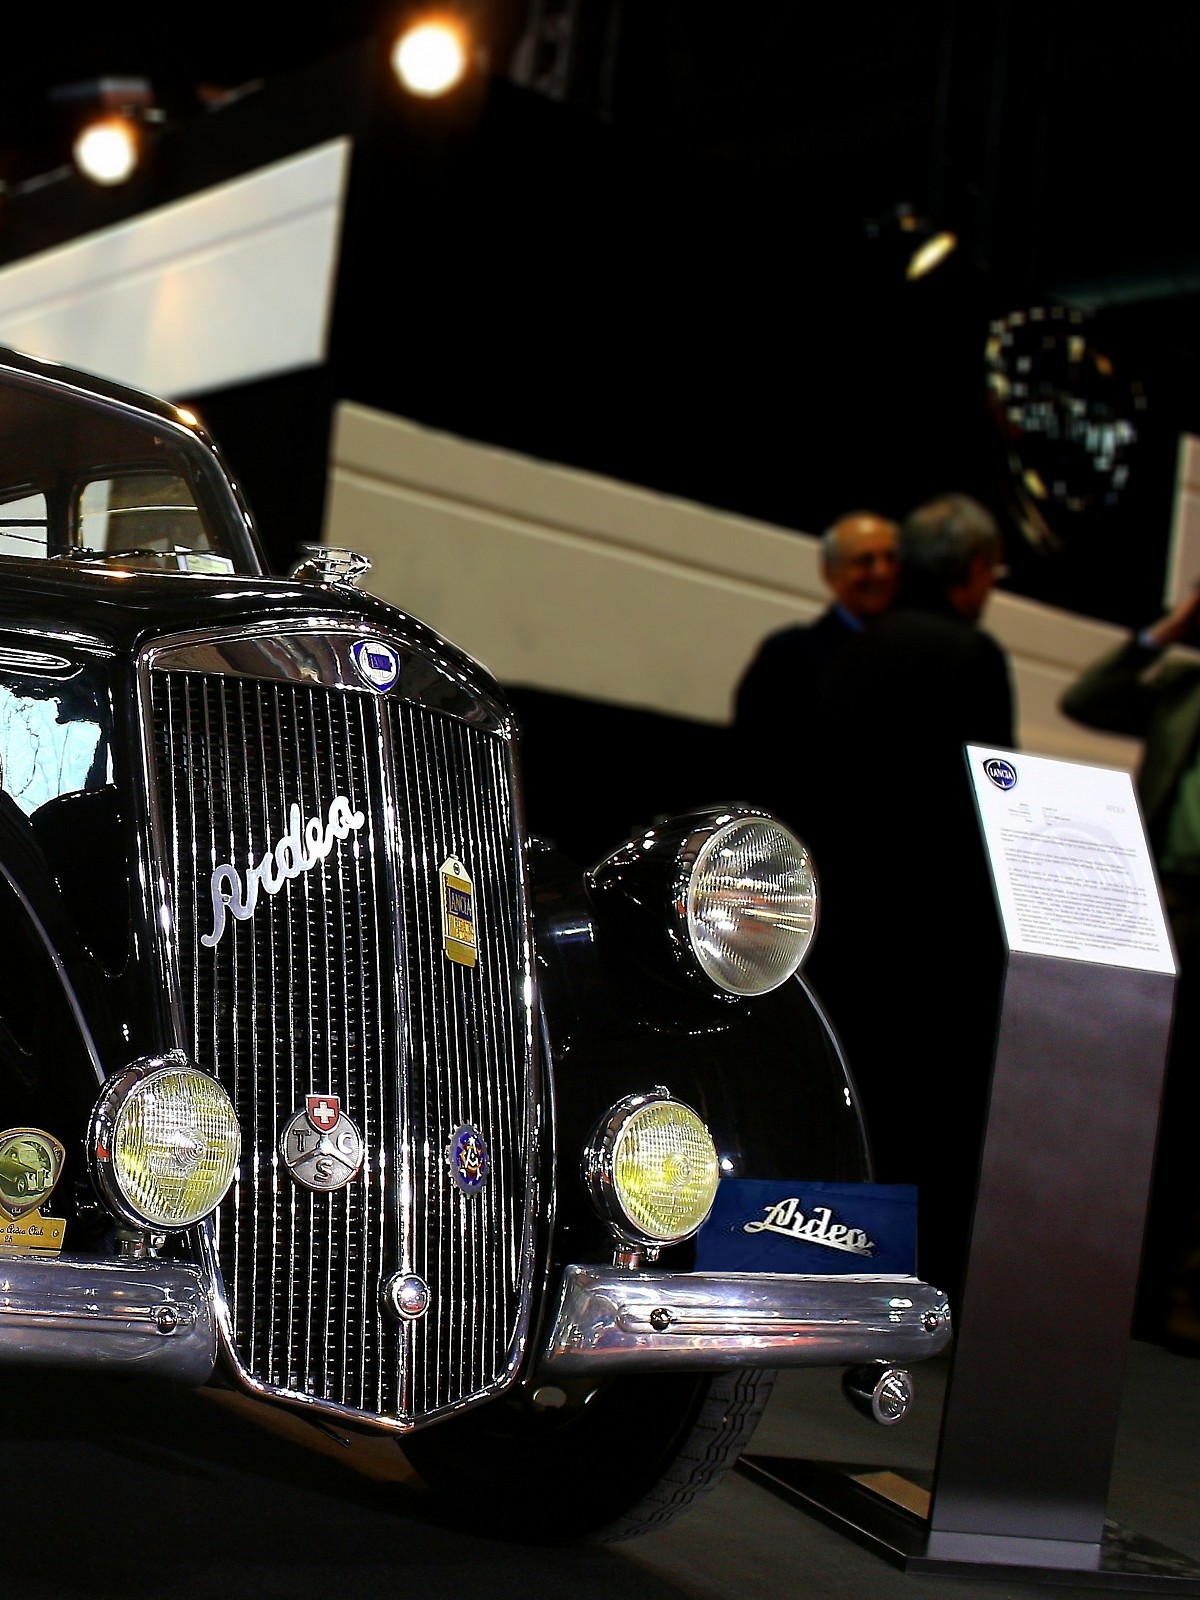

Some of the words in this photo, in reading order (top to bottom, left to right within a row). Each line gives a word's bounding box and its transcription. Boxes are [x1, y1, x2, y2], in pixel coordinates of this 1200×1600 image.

[201, 795, 365, 947] Ardea
[6, 1223, 26, 1235] Ardea
[28, 1225, 44, 1236] Club
[743, 1197, 876, 1258] Ardea
